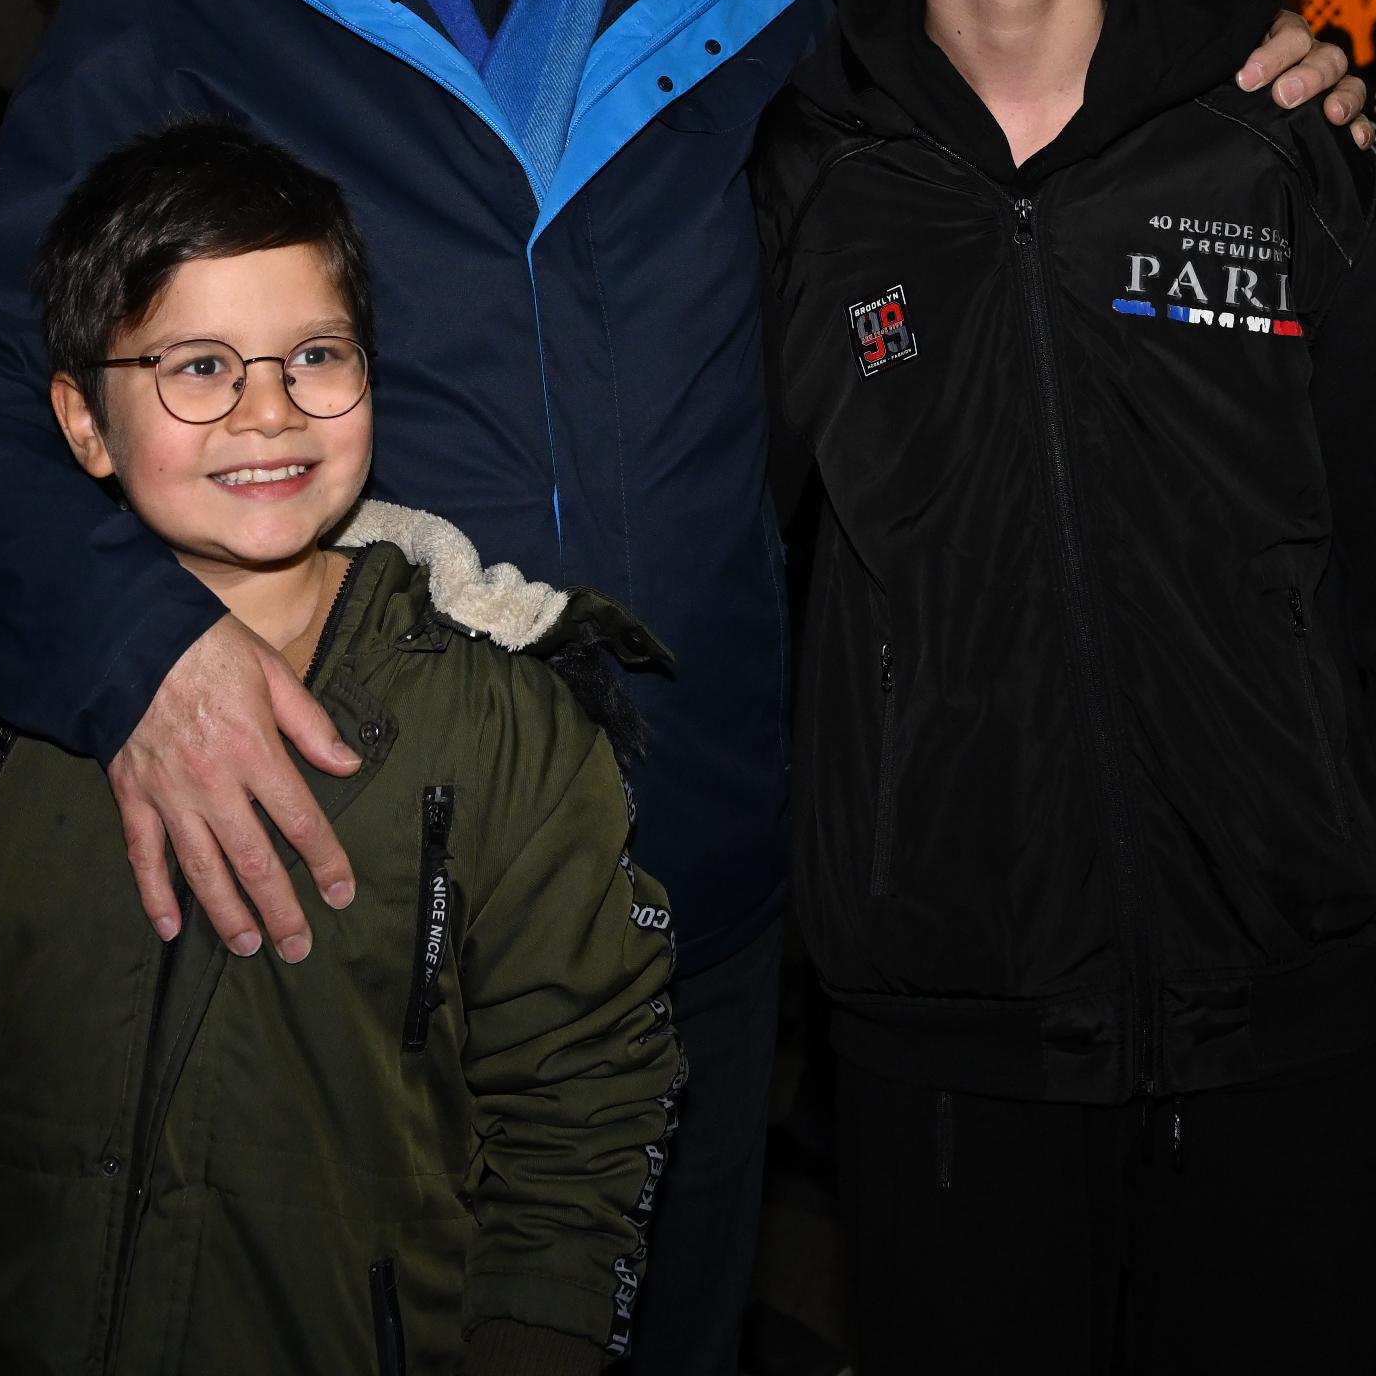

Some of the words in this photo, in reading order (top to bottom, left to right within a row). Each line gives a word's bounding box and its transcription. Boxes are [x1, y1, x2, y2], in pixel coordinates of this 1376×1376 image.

[1149, 215, 1173, 230] 40
[1182, 237, 1283, 262] PREMIUM
[854, 292, 899, 317] BROOKLYN
[432, 876, 447, 922] NICE
[425, 924, 444, 965] NICE
[638, 1144, 665, 1212] KEEP
[614, 1257, 638, 1320] KEEP
